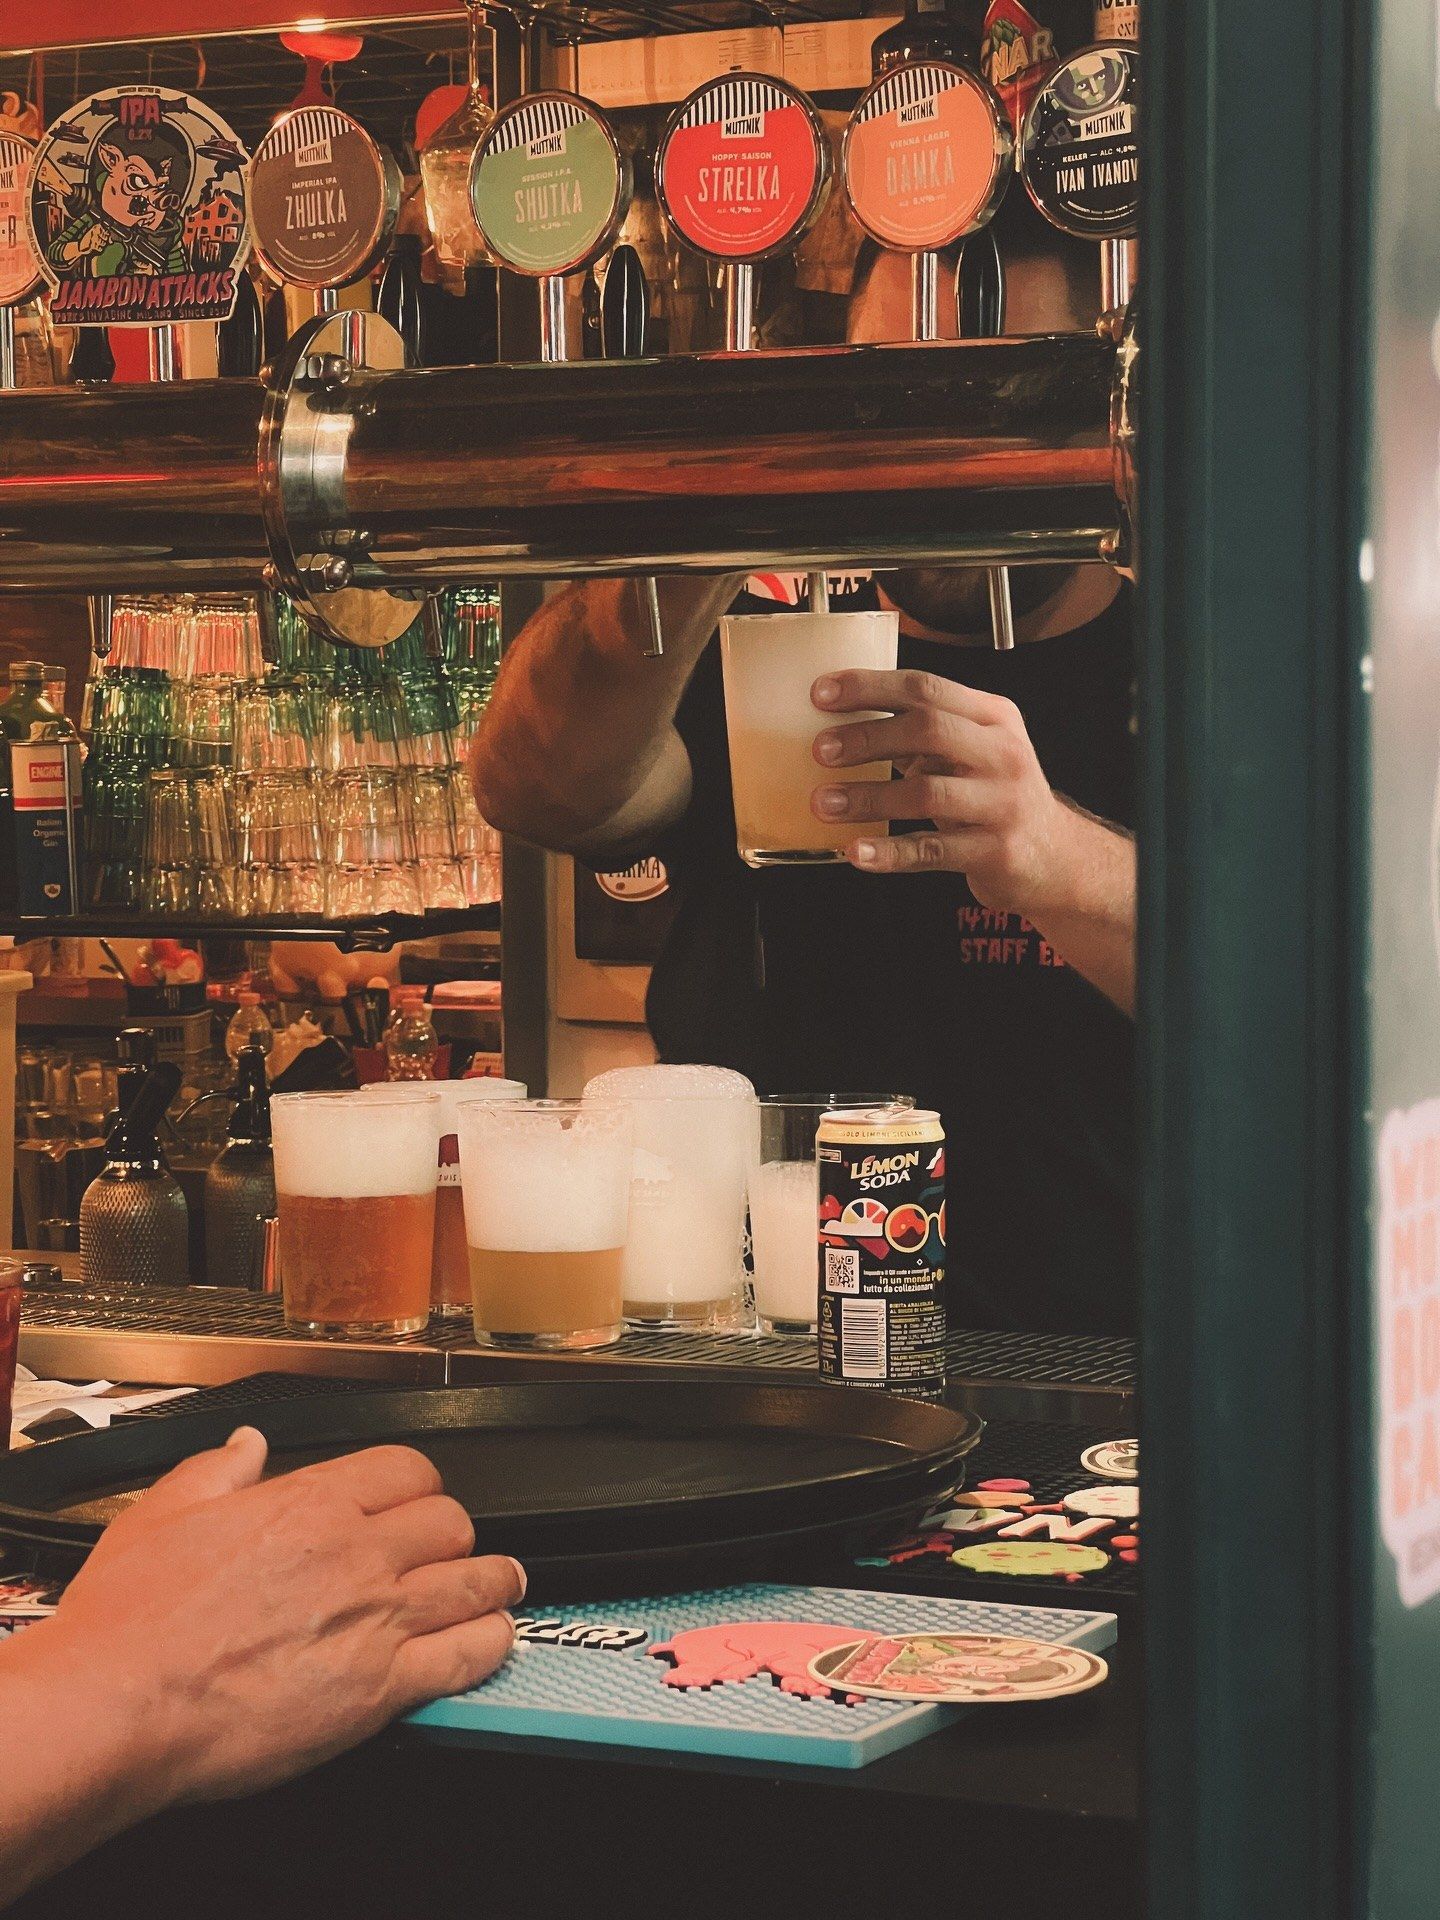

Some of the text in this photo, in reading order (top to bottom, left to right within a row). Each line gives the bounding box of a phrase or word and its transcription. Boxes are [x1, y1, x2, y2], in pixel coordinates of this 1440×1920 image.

[981, 31, 1054, 86] NAR
[120, 98, 160, 128] IPA
[900, 99, 935, 122] MUTTNIK
[725, 116, 761, 135] MUTTNIK
[1085, 110, 1126, 136] MUTTNIK
[530, 134, 562, 156] MUTTNIK
[890, 130, 950, 150] VIENNA LAGER
[299, 143, 329, 163] MUTTNIK
[712, 152, 772, 161] HOPPY SAISON
[1062, 153, 1088, 163] KELLER
[1100, 148, 1113, 157] ALC
[291, 176, 337, 189] IMPERIAL IPA
[522, 171, 553, 183] SESSION
[698, 165, 780, 202] STRELKA
[1056, 167, 1085, 194] IVAN
[285, 189, 347, 230] ZHULKA
[515, 179, 582, 223] SHUTKA
[52, 270, 236, 311] JAMBON ATTACKS
[180, 307, 205, 318] SINCE
[31, 766, 64, 779] ENGINE
[36, 819, 63, 827] Italian
[33, 829, 66, 839] Organic
[43, 839, 58, 847] Gin
[960, 937, 1029, 965] STAFF
[850, 1150, 920, 1180] LEMON
[859, 1170, 911, 1191] SODA
[863, 1283, 934, 1293] tutto da collezionare
[880, 1276, 889, 1284] in
[904, 1274, 931, 1283] mondo
